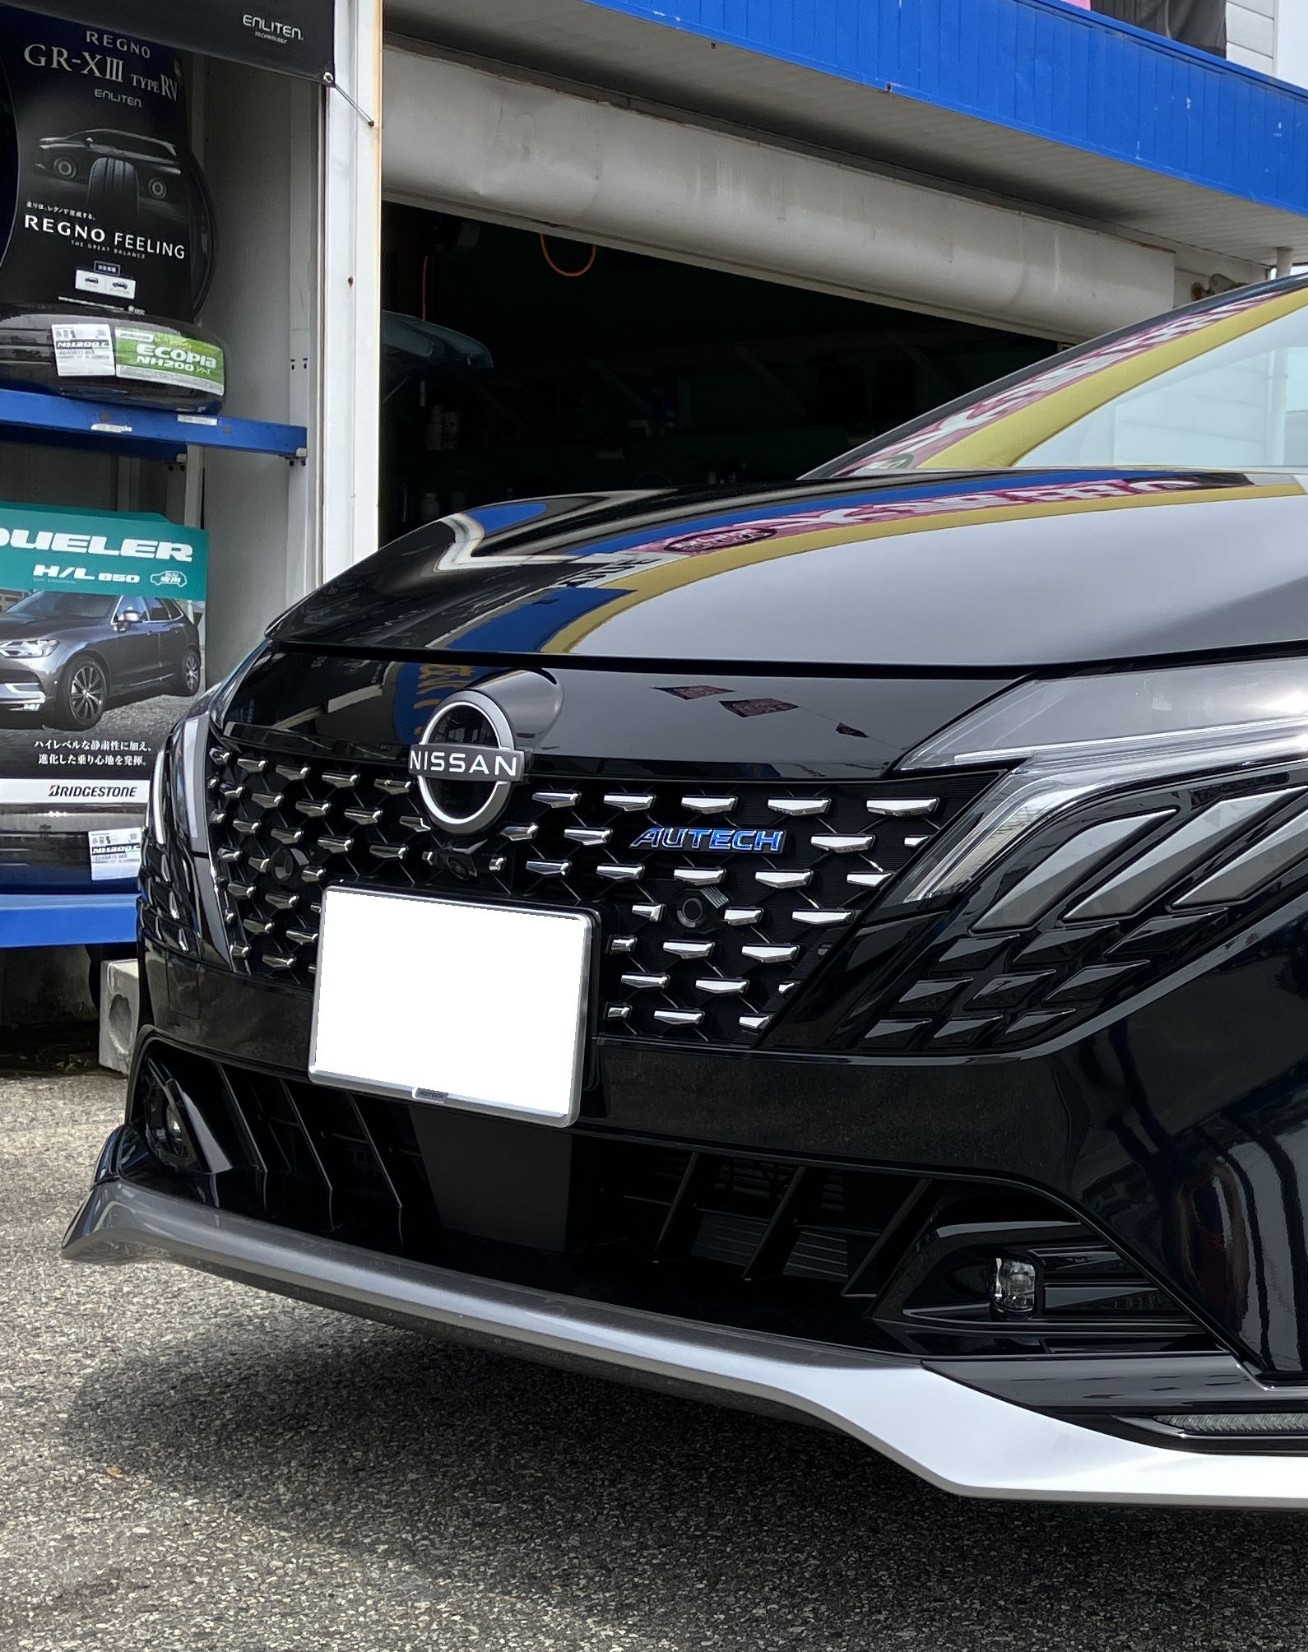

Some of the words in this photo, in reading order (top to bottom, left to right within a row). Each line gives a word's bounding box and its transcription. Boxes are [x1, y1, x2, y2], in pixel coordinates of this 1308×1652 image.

[242, 14, 302, 40] ENLITEN
[86, 30, 151, 58] REGNO
[94, 88, 142, 108] ENLITEN
[130, 74, 160, 94] TYPE
[160, 74, 178, 102] RV
[24, 214, 106, 242] REGNO
[114, 232, 186, 259] FEELING
[137, 355, 195, 372] NH200
[0, 527, 193, 562] UELER
[33, 564, 96, 580] H/L
[97, 573, 141, 584] 850
[409, 750, 517, 777] NISSAN
[48, 785, 138, 798] BRIDGESTONE
[629, 827, 784, 852] AUTECH
